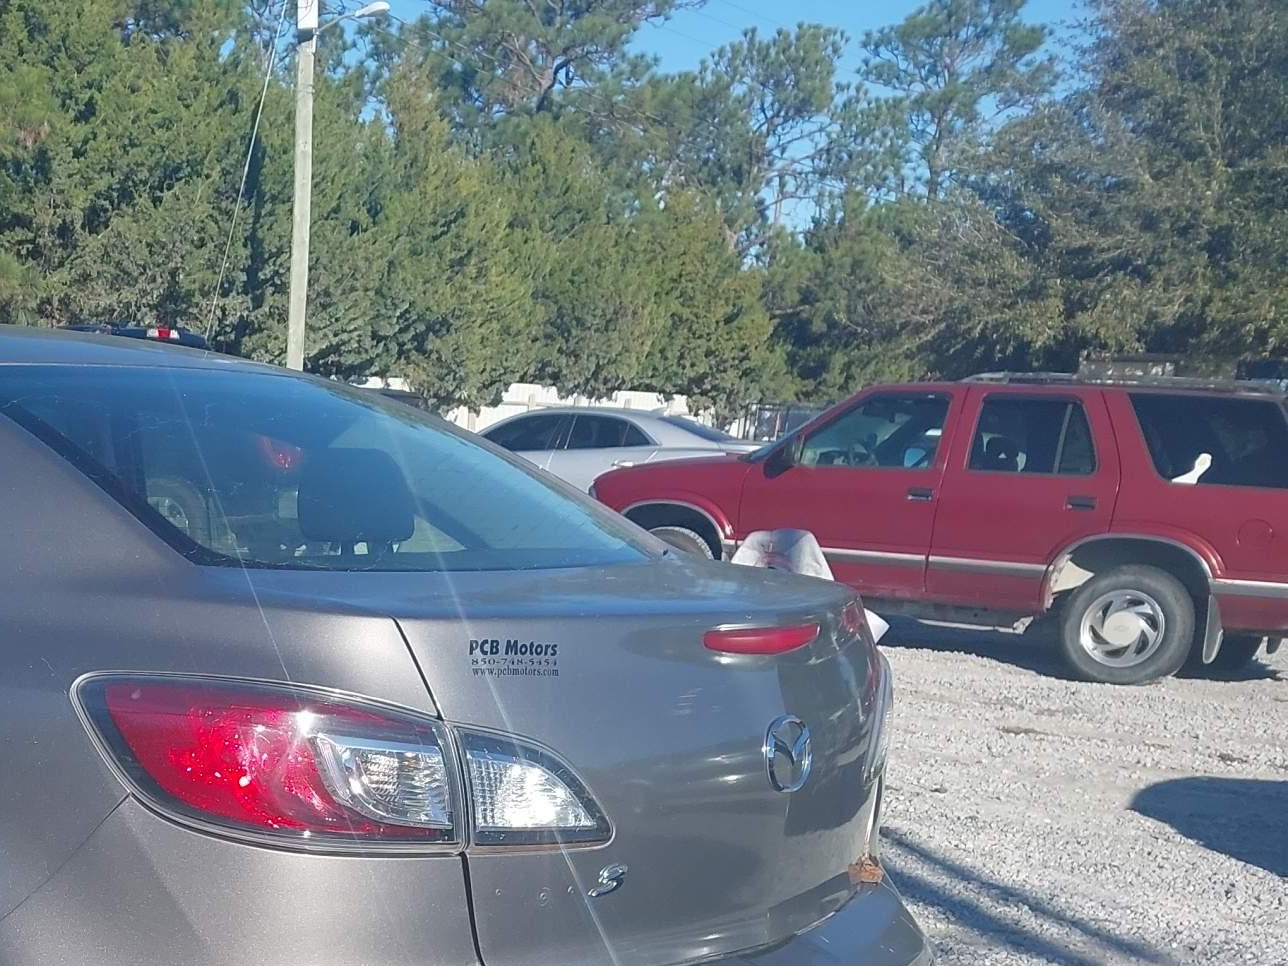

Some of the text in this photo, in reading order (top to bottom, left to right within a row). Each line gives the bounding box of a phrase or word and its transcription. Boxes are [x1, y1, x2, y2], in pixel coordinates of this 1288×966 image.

[469, 639, 558, 656] PCB Motors
[471, 665, 560, 678] www.pcbmotors.com
